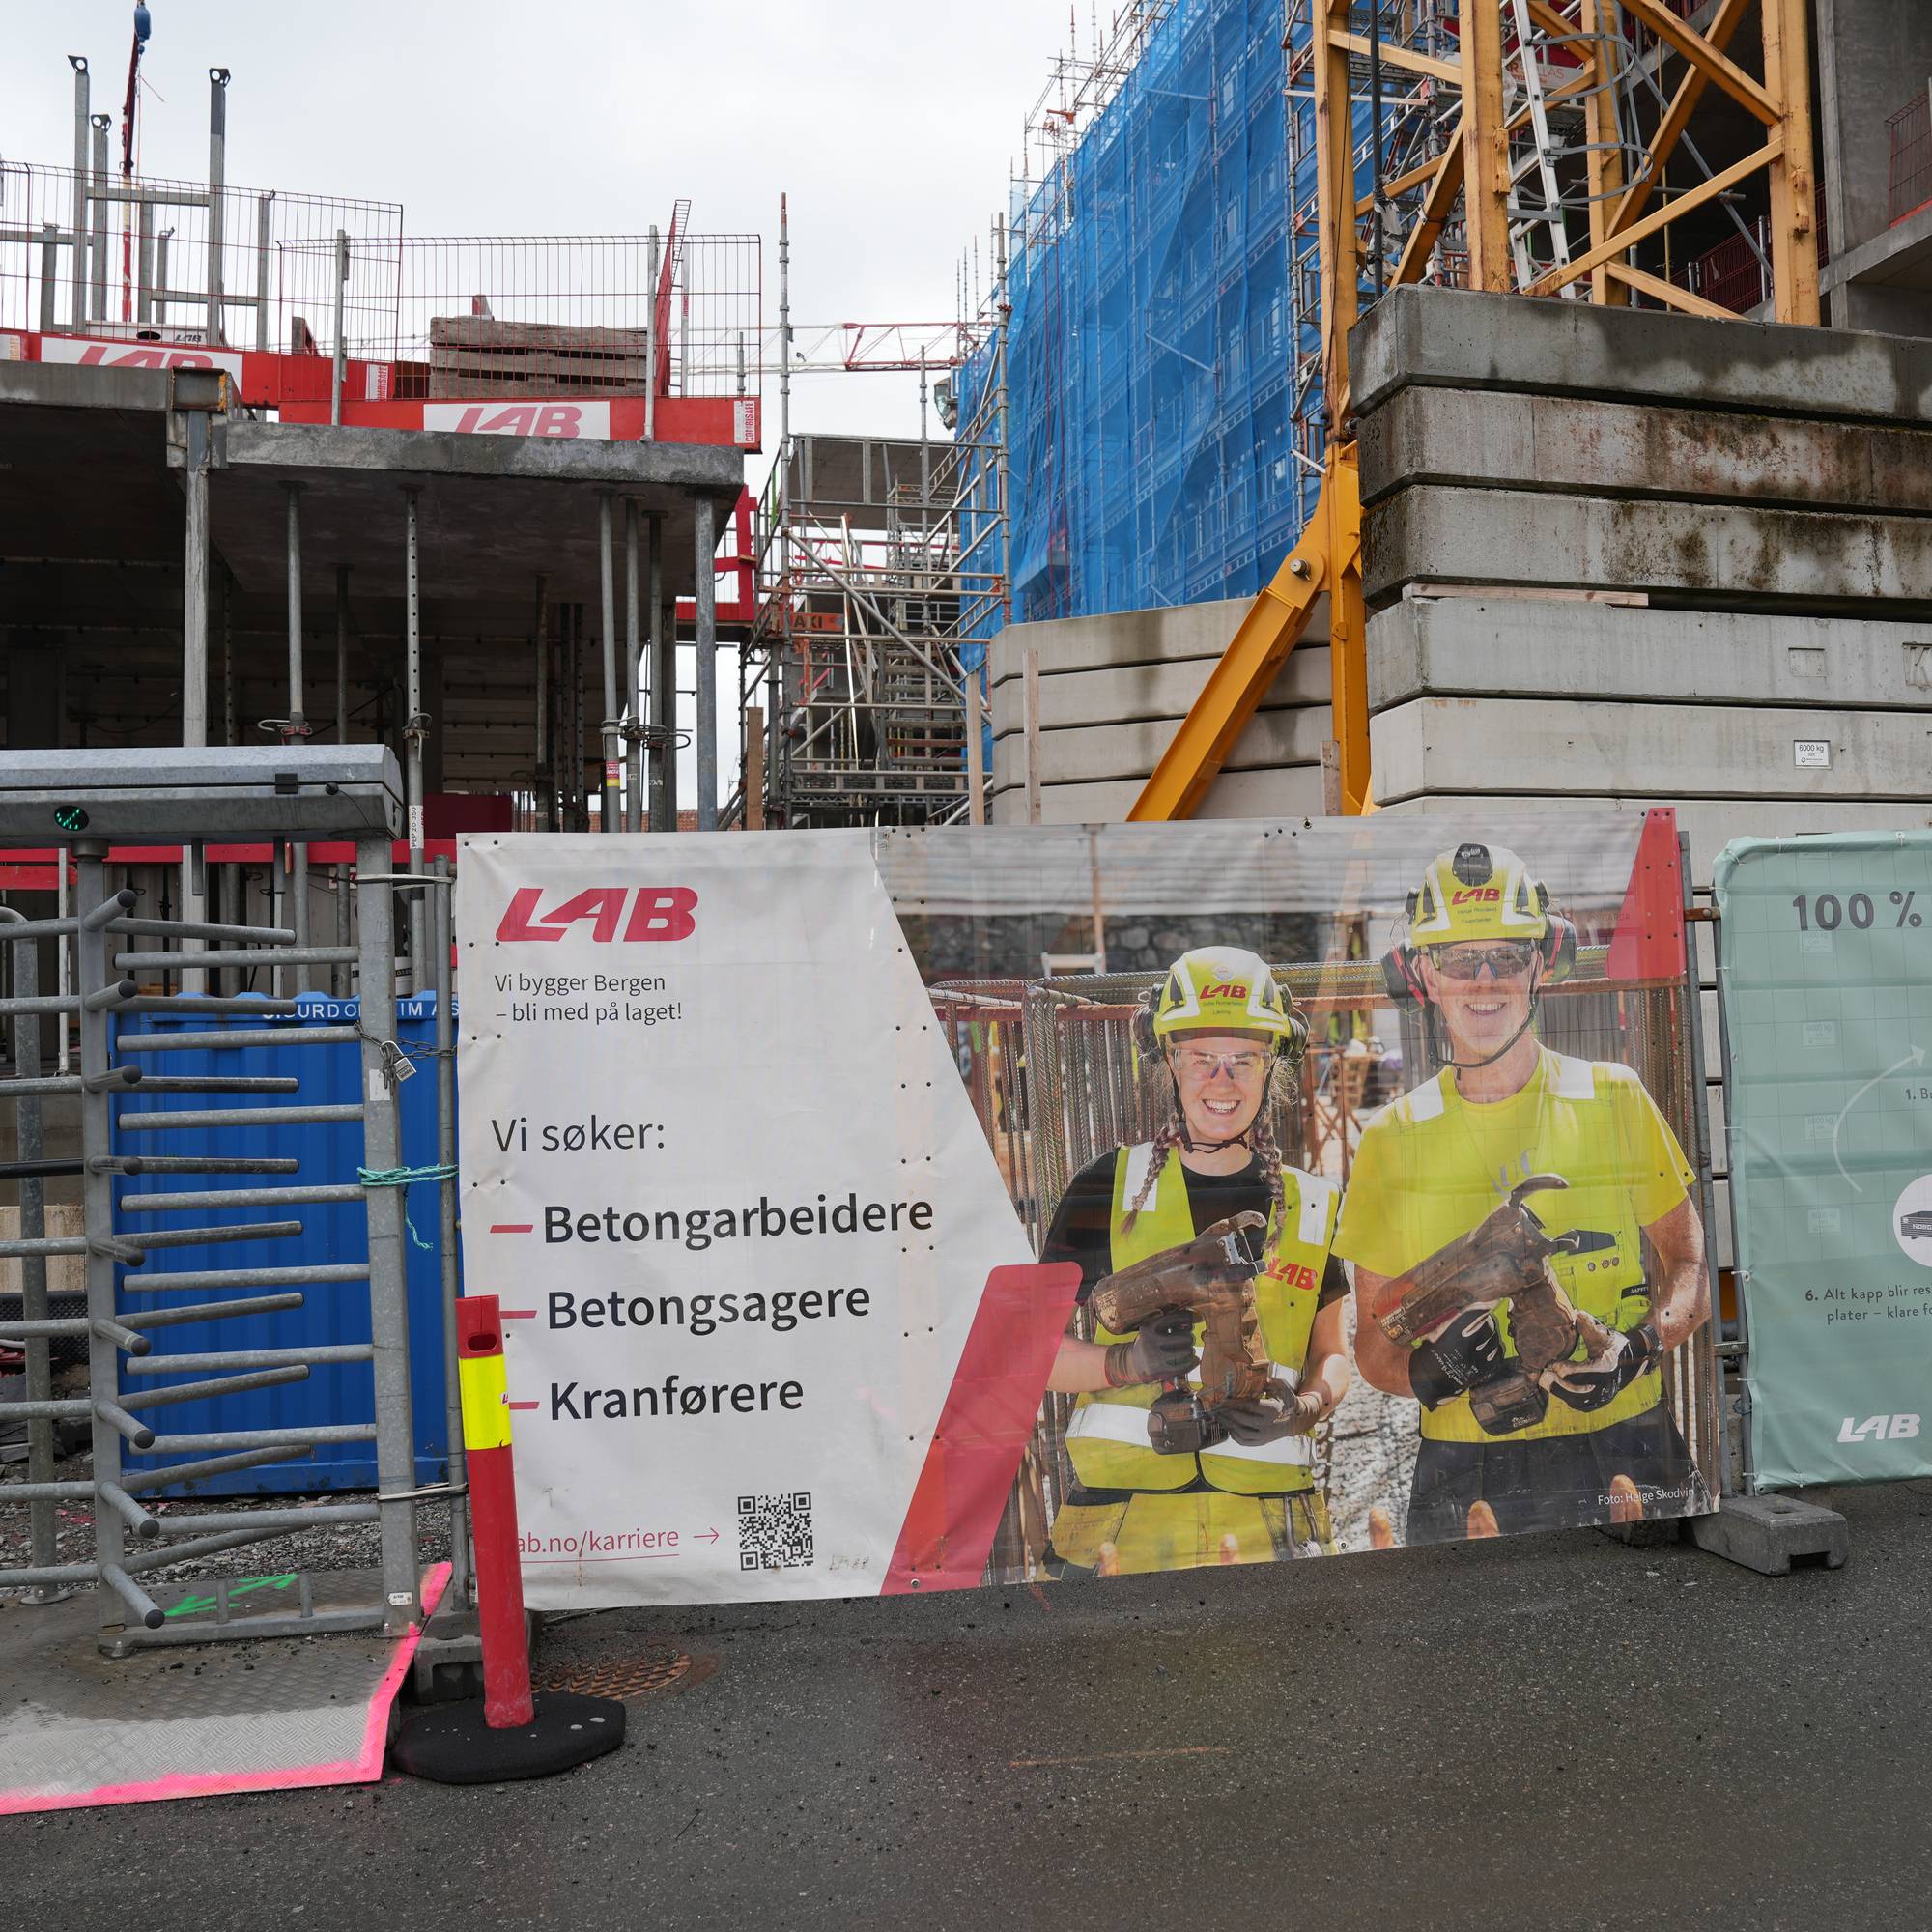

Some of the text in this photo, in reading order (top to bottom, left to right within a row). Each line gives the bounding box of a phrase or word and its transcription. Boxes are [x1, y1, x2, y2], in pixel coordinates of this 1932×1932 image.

[176, 334, 201, 343] LAB
[1816, 744, 1825, 753] kg
[1452, 888, 1501, 906] LAB
[496, 887, 698, 943] LAB
[1793, 891, 1922, 931] 100 %
[494, 973, 666, 997] Vi bygger Bergen
[1200, 984, 1247, 1000] LAB
[512, 1002, 537, 1021] bli
[544, 1002, 589, 1021] med
[595, 1002, 619, 1025] på
[626, 1002, 682, 1026] laget!
[1905, 1087, 1932, 1100] 1. B
[491, 1114, 666, 1152] Vi søker:
[544, 1192, 934, 1251] Betongarbeidere
[1265, 1257, 1318, 1291] LAB
[1804, 1289, 1818, 1301] 6.
[1824, 1288, 1846, 1300] Alt
[1851, 1288, 1883, 1303] kapp
[1888, 1285, 1909, 1297] blir
[548, 1286, 871, 1336] Betongsagere
[1827, 1309, 1868, 1325] plater
[1887, 1306, 1918, 1319] klare
[552, 1375, 804, 1421] Kranførere
[1837, 1414, 1921, 1443] LAB
[1598, 1488, 1695, 1506] Foto: Helge Skodvin
[517, 1527, 679, 1554] ab.no/karriere
